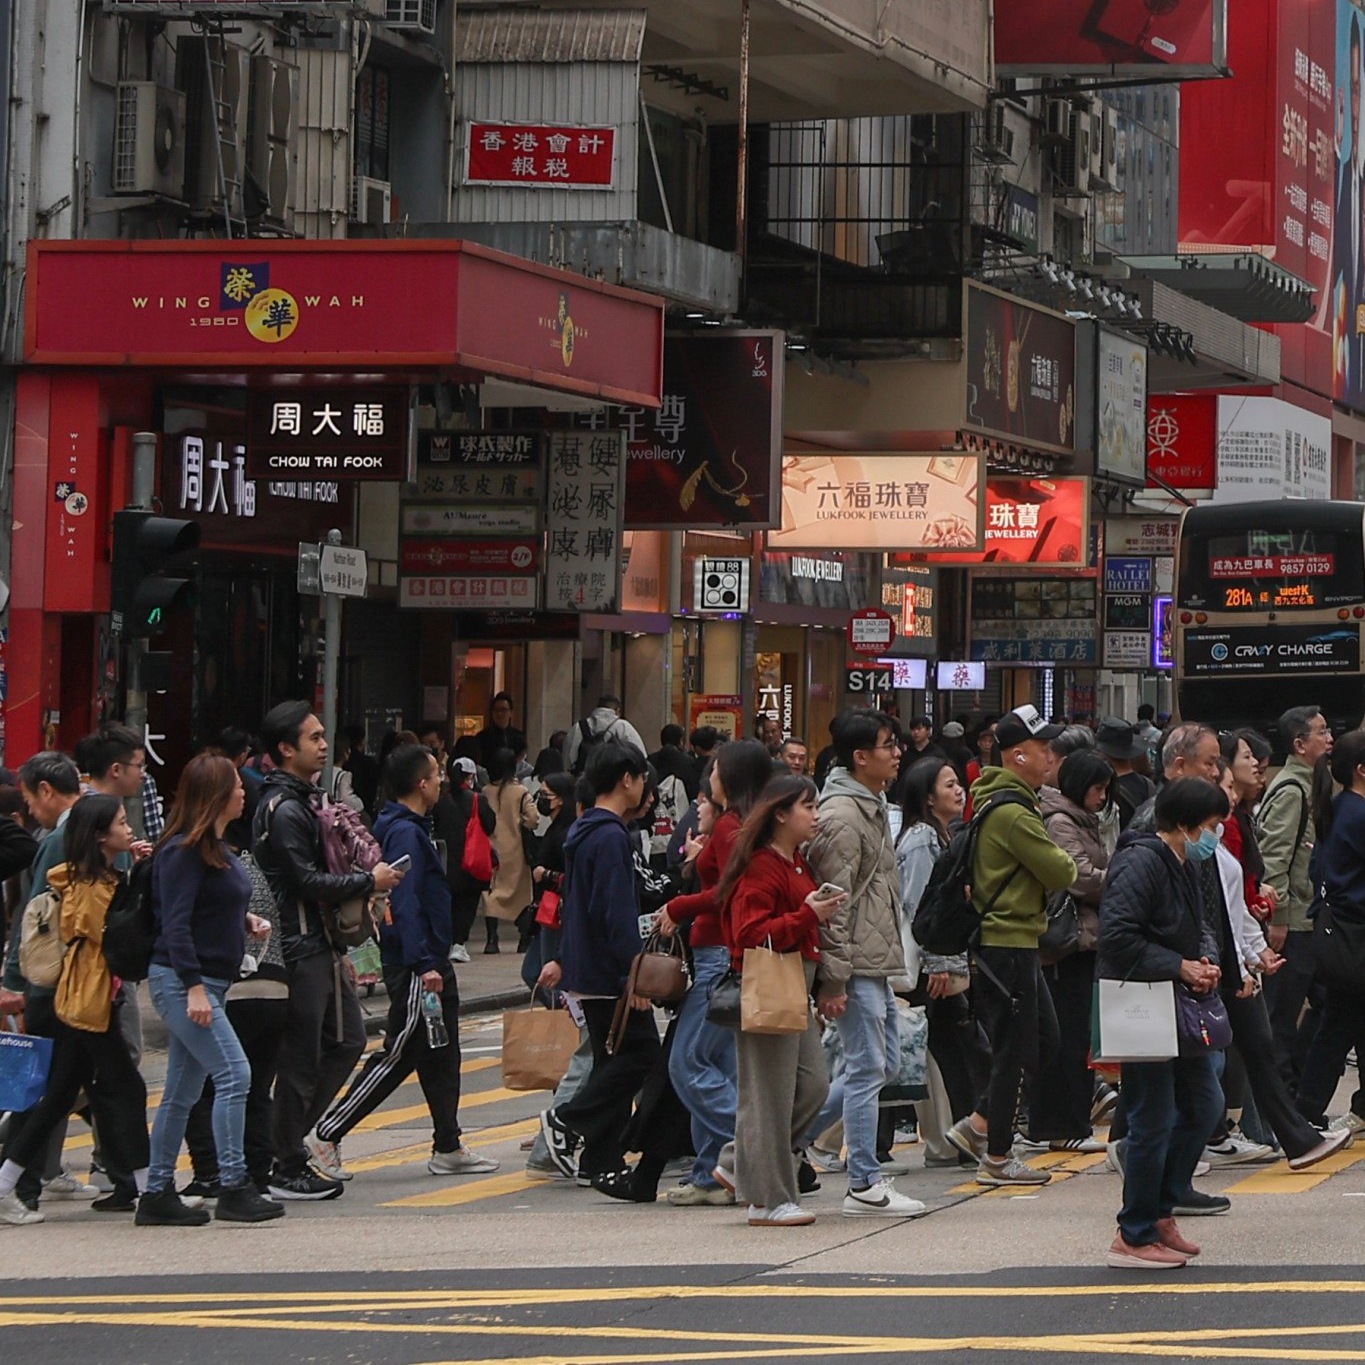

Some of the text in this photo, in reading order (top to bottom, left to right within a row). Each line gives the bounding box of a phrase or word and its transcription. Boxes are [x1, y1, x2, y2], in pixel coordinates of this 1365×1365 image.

[478, 129, 606, 156] 香港會計
[132, 267, 365, 338] WING 榮 華 WAH
[270, 402, 385, 437] 周大福
[269, 456, 384, 468] CHOW TAI FOOK
[179, 435, 257, 518] 周大福
[816, 481, 930, 509] 六福珠寶
[816, 511, 929, 522] LUKFOOK JEWELLERY
[989, 503, 1041, 529] 珠寶
[705, 561, 740, 573] 眼鏡88
[1213, 559, 1274, 571] 成為九巴車長
[1280, 562, 1331, 574] 9857 0129
[1108, 581, 1146, 591] HOTEL
[1114, 597, 1142, 607] MGM
[1225, 588, 1253, 607] 281A
[1234, 643, 1333, 657] CRAZY CHARGE
[849, 671, 892, 691] S14
[893, 660, 912, 685] 藥
[951, 664, 972, 688] 藥
